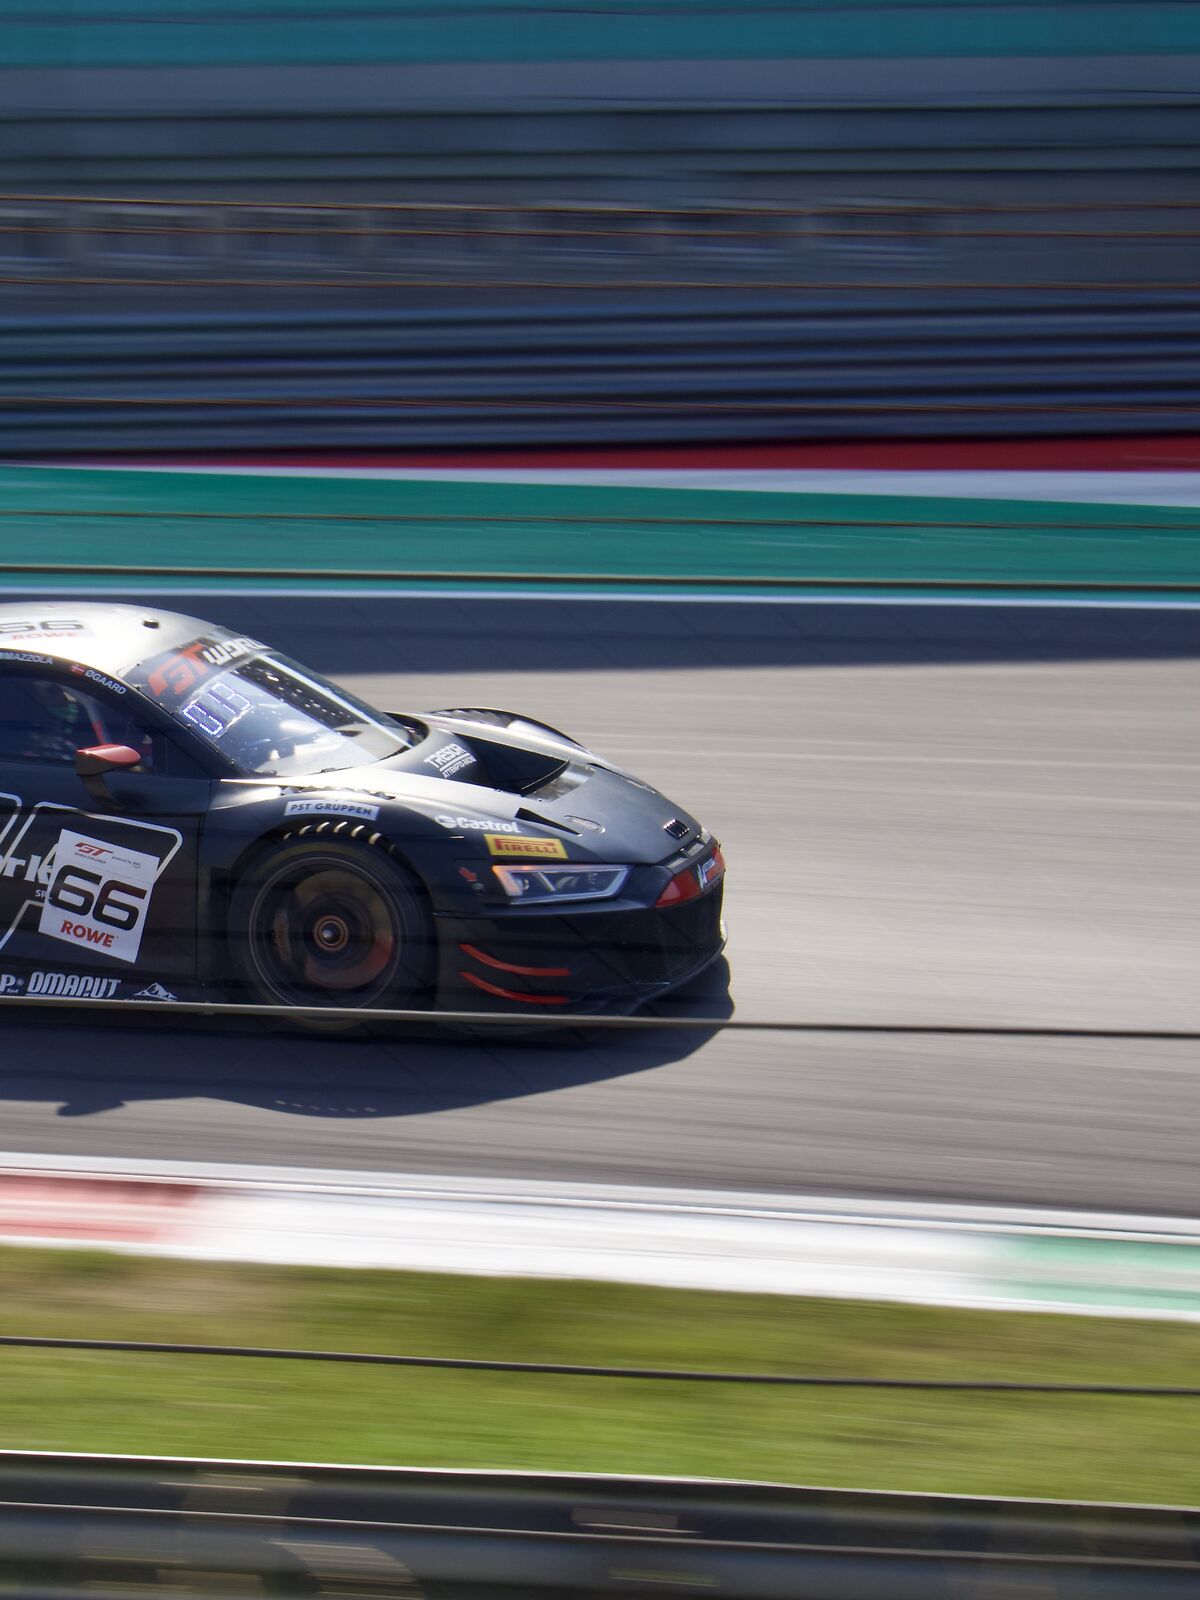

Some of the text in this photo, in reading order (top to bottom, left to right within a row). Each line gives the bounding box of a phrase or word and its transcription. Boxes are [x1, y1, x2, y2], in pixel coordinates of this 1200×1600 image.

[4, 651, 53, 665] MAZZOLA
[148, 641, 208, 697] GT
[290, 802, 373, 816] PST GRUPPEN
[454, 816, 521, 833] Castrol
[493, 838, 559, 855] PIRELLI
[49, 864, 148, 931] 66
[60, 919, 115, 948] ROWE
